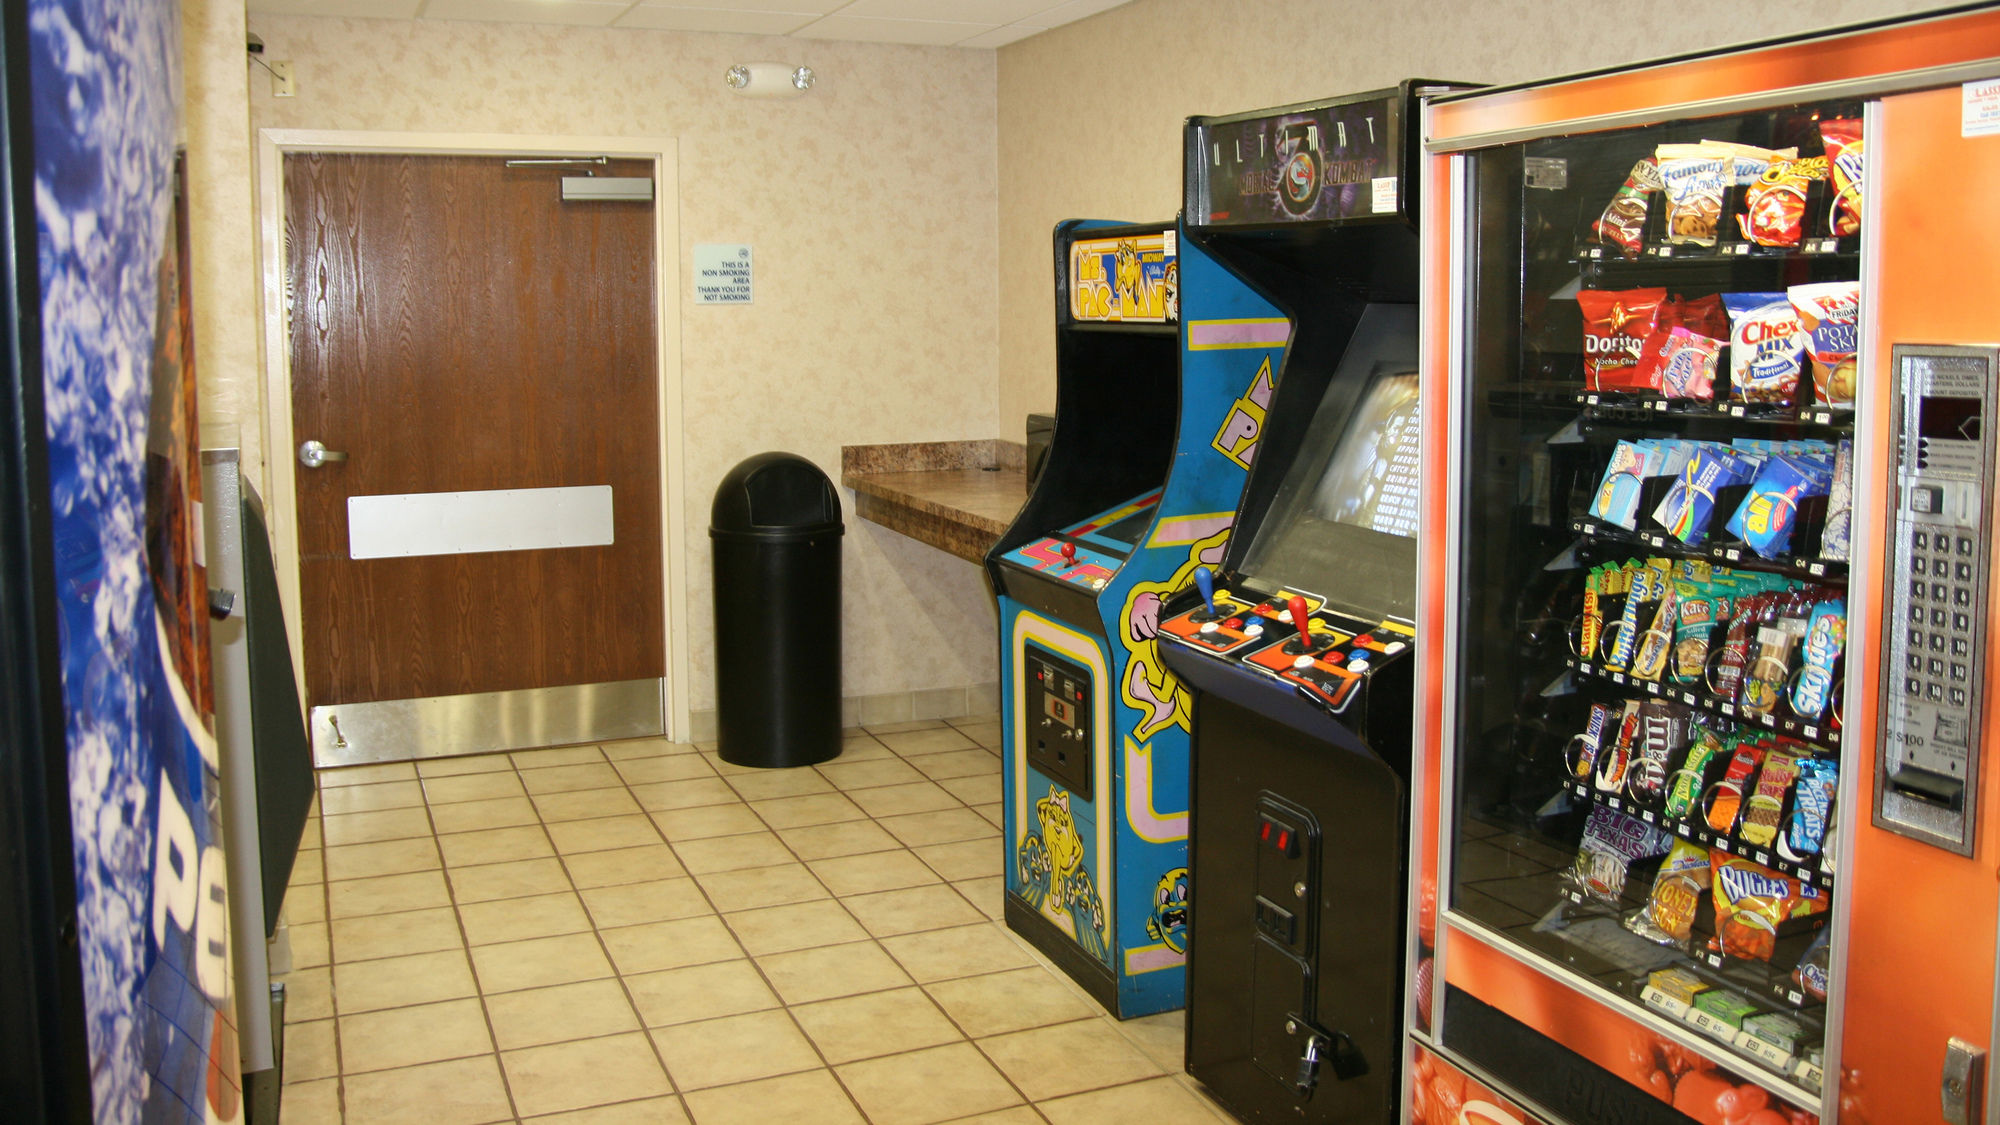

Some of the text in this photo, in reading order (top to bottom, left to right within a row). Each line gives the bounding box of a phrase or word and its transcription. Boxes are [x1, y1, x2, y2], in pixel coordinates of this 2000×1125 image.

[1605, 212, 1628, 228] Mini
[1722, 246, 1732, 254] A3
[1805, 243, 1816, 252] A4
[721, 261, 750, 269] THIS IS A
[702, 269, 750, 277] NON SMOKING
[733, 277, 750, 285] AREA
[697, 286, 750, 294] THANK YOU FOR
[704, 294, 751, 302] NOT SMOKING
[1741, 318, 1799, 345] Chex
[1585, 332, 1646, 353] Dorito
[1756, 337, 1794, 362] MIX
[1752, 362, 1791, 379] Traditional
[1718, 403, 1728, 412] B3
[1800, 411, 1811, 420] B4
[1573, 523, 1581, 531] C1
[1640, 533, 1650, 541] C2
[1713, 548, 1723, 557] C3
[1795, 559, 1807, 568] C4
[1579, 591, 1594, 657] Starburst
[1632, 679, 1640, 687] D3
[1667, 689, 1676, 698] D4
[1785, 721, 1796, 730] D7
[1593, 803, 1647, 841] BIG
[1585, 819, 1645, 861] TEXAS
[1778, 862, 1788, 871] E7
[1718, 865, 1790, 905] BUGLES
[1774, 985, 1784, 994] F4
